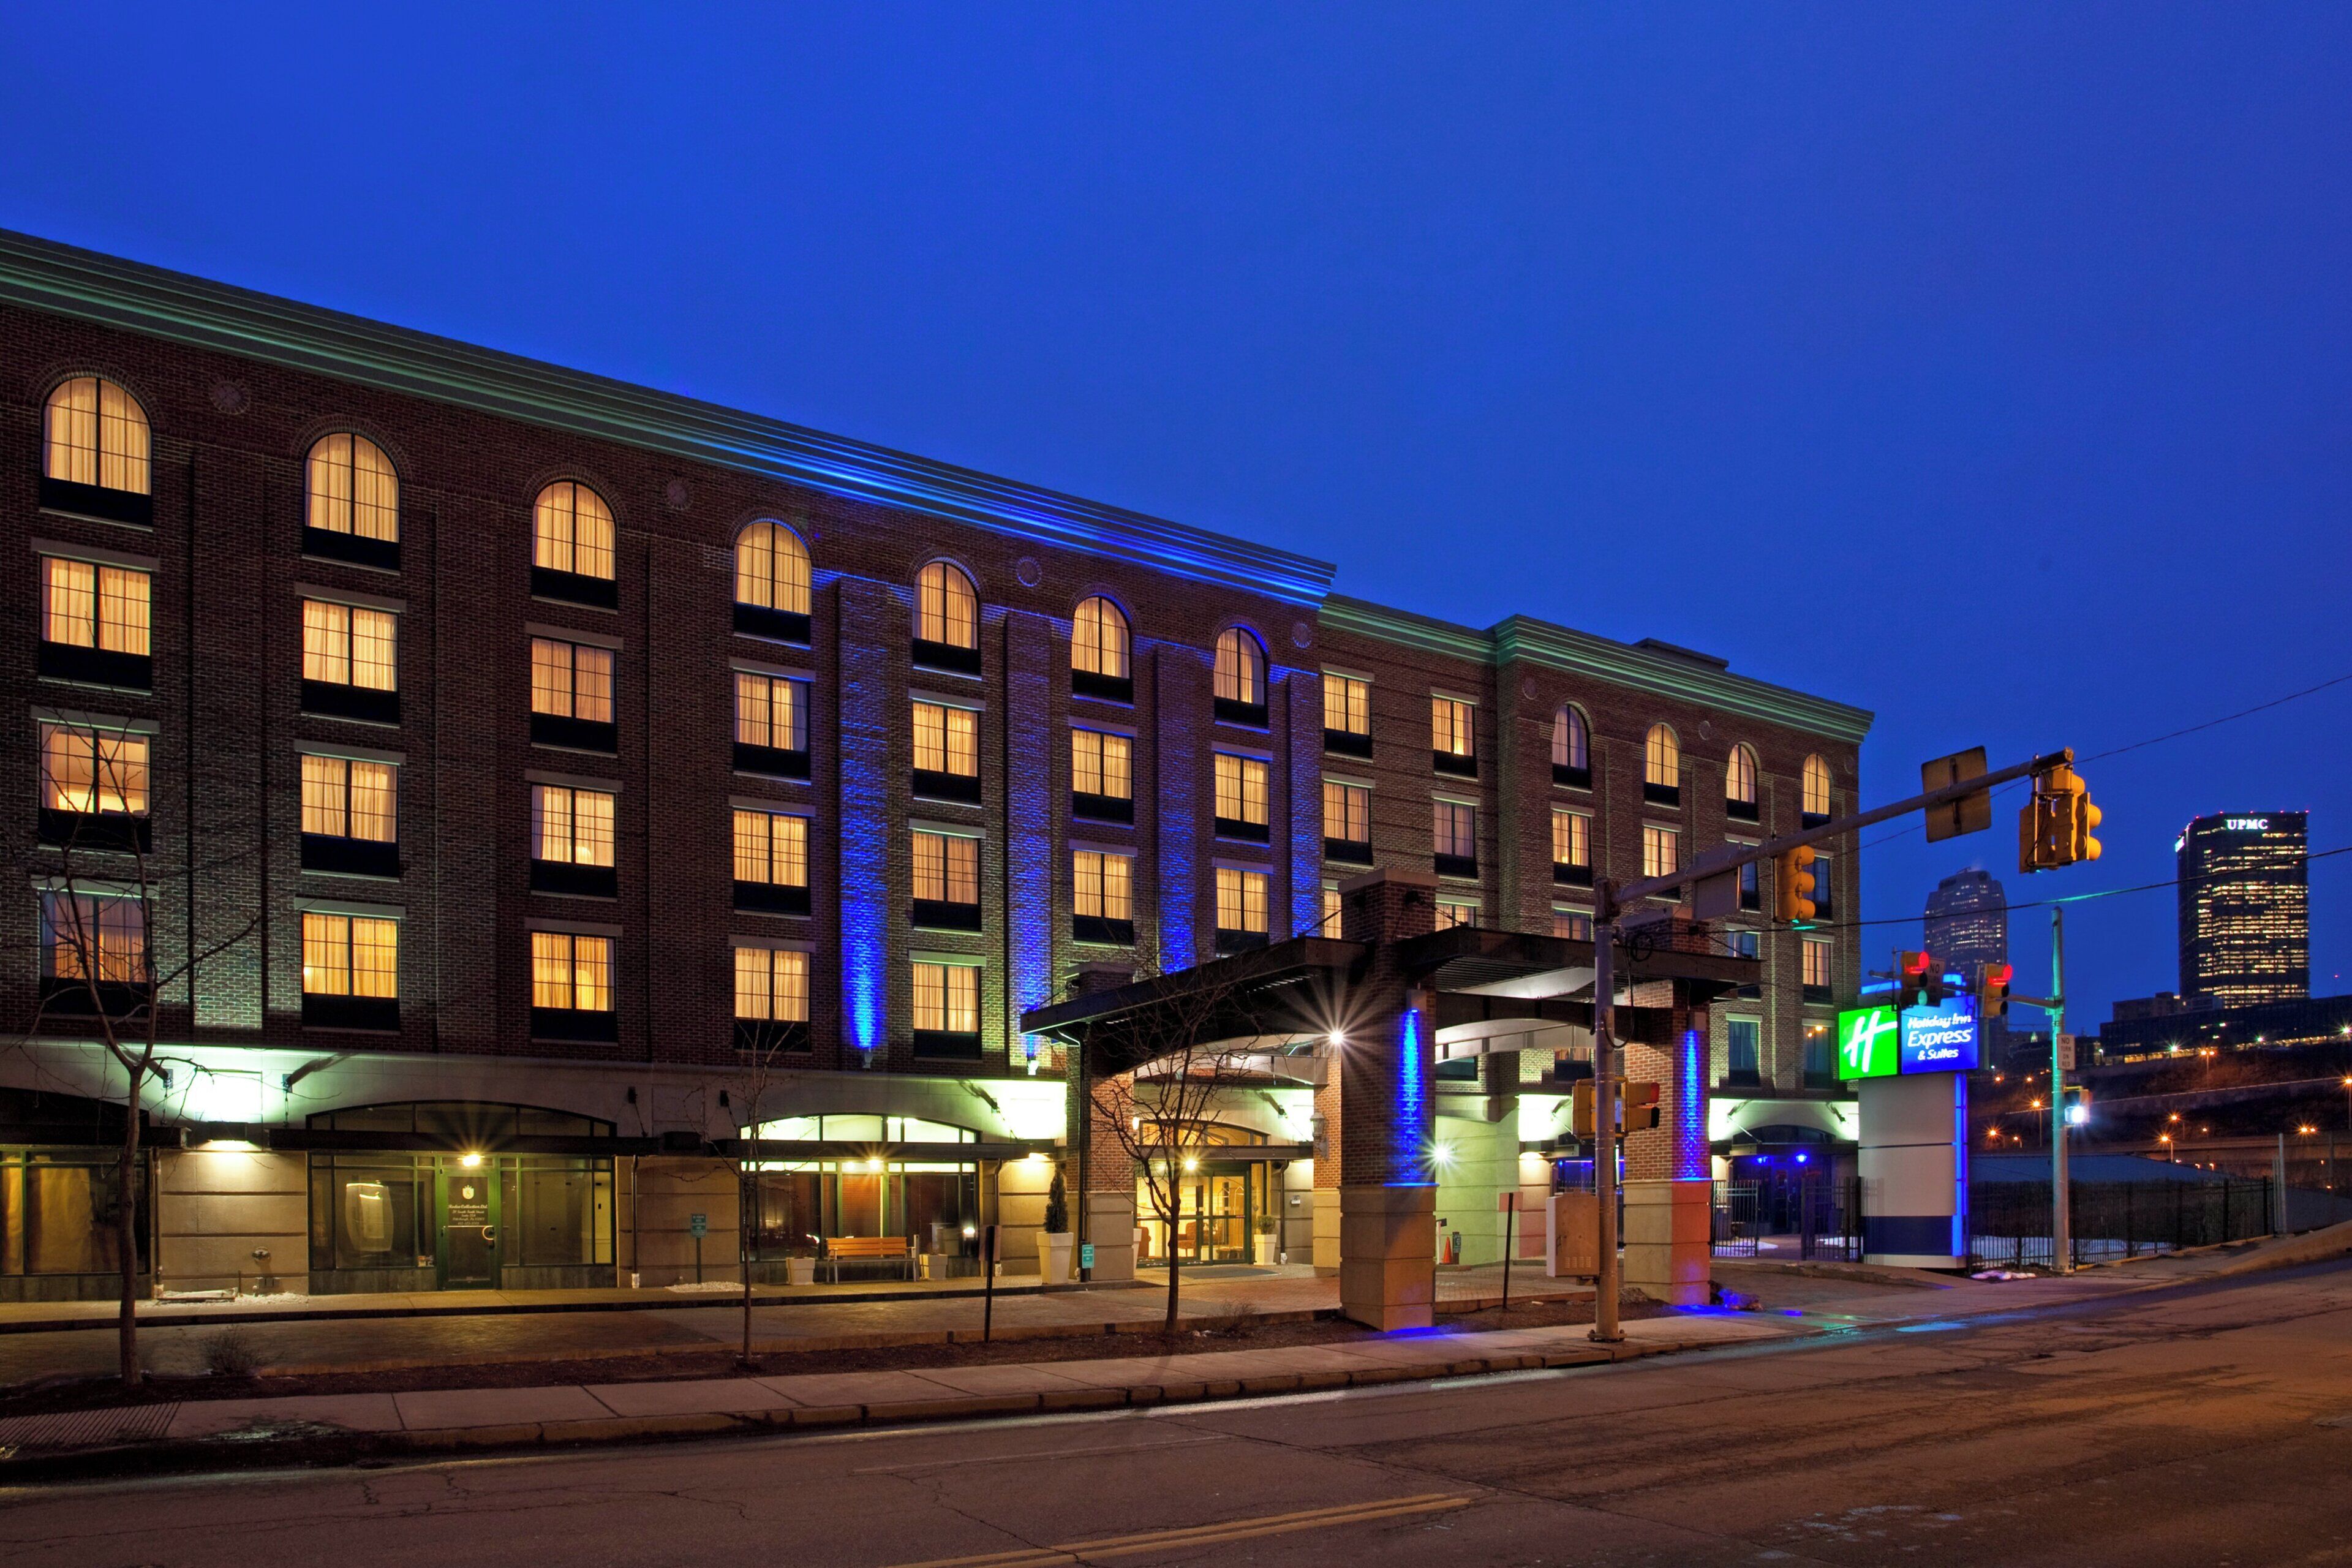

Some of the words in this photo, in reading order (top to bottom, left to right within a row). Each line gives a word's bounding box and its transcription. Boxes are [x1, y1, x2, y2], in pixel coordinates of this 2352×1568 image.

[2226, 819, 2268, 830] UPMC
[1930, 963, 1940, 973] NO
[1907, 1015, 1951, 1029] Holiday
[1952, 1012, 1972, 1025] Inn
[1907, 1029, 1972, 1049] Express
[1918, 1050, 1926, 1060] &
[1927, 1048, 1959, 1060] Suites
